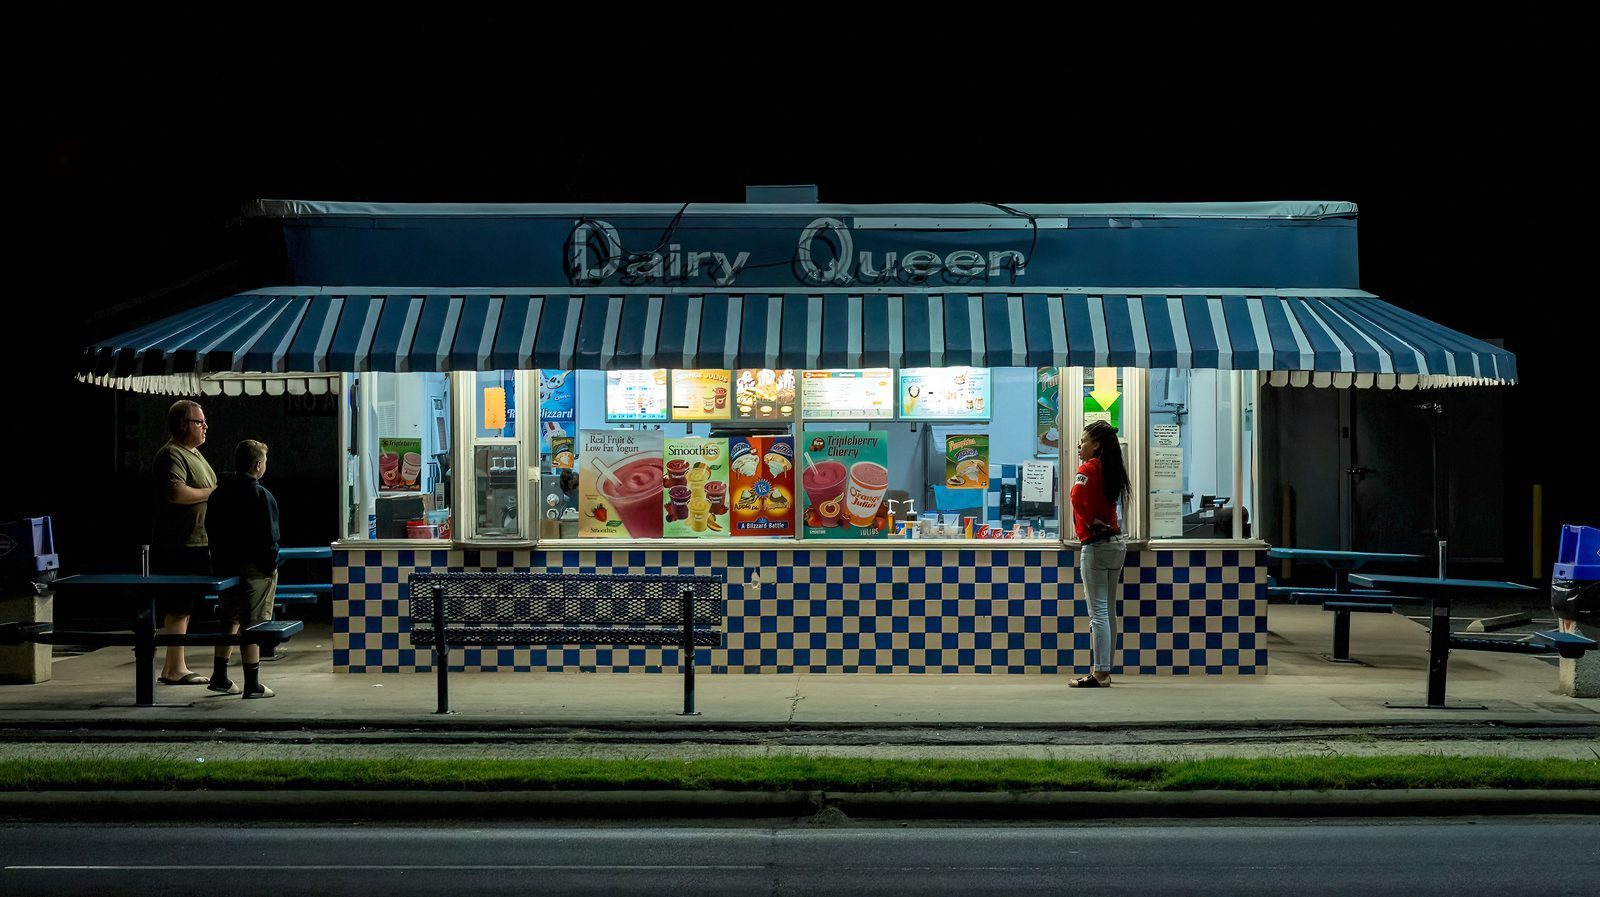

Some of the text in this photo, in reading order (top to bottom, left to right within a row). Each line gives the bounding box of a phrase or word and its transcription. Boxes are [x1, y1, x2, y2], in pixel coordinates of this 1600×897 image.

[573, 217, 1026, 285] Dairy Queen
[674, 373, 728, 383] ONGE JULIUS
[590, 435, 634, 444] Real Fruit &
[828, 435, 878, 447] Tripleberry
[585, 444, 639, 454] Low Fat Yogurt
[668, 444, 718, 456] Smoothies
[828, 446, 859, 458] Cherry
[851, 498, 876, 508] Julius
[860, 528, 879, 536] JULIUS
